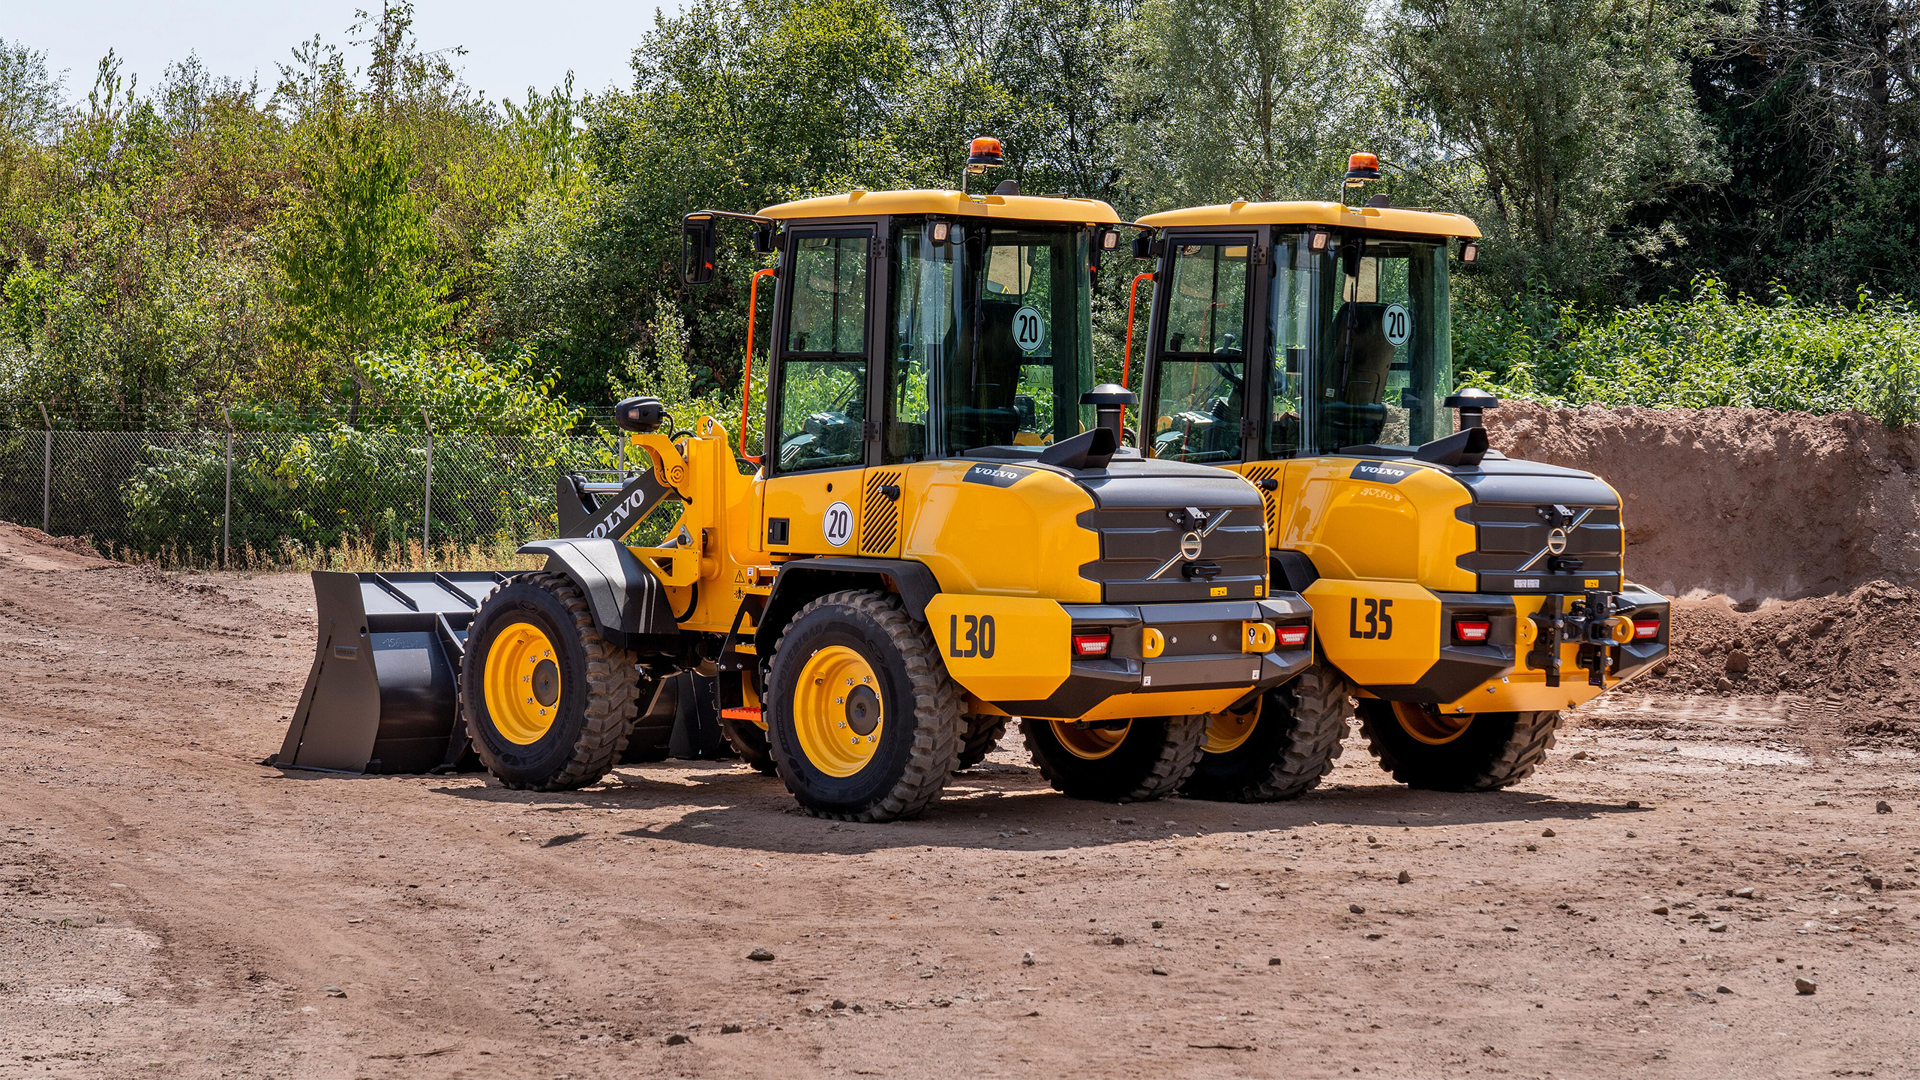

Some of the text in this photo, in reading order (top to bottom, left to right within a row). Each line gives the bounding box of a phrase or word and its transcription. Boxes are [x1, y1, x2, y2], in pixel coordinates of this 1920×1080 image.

[1019, 314, 1038, 343] 20
[1388, 311, 1405, 338] 20
[974, 466, 1018, 480] VOLVO
[1360, 465, 1405, 477] VOLVO
[828, 509, 848, 539] 20
[1350, 597, 1393, 640] L35
[950, 614, 996, 659] L30
